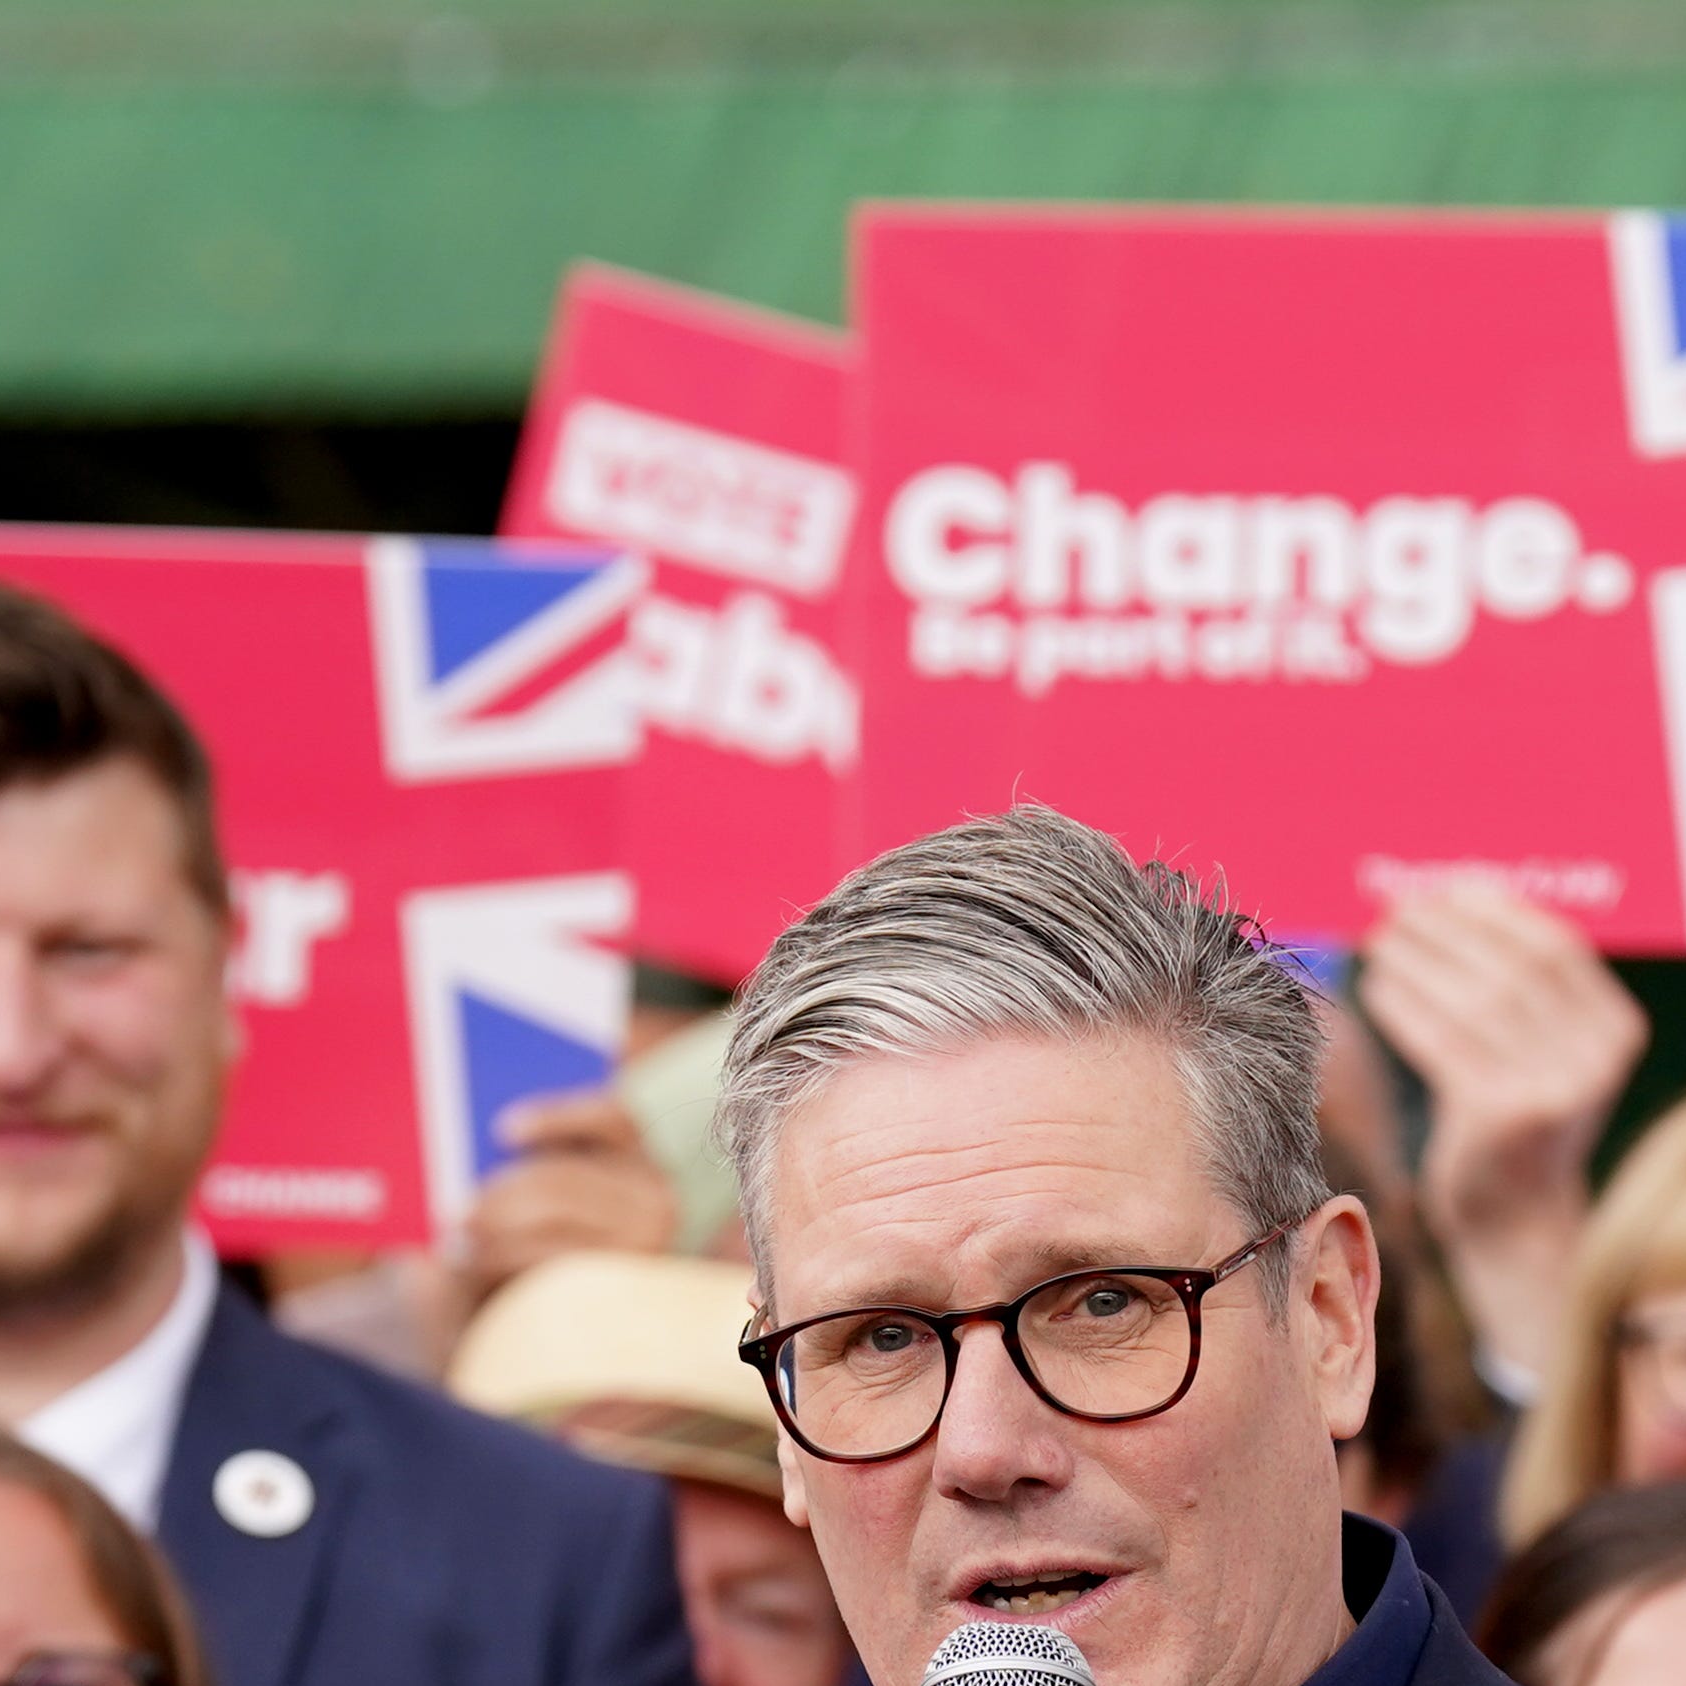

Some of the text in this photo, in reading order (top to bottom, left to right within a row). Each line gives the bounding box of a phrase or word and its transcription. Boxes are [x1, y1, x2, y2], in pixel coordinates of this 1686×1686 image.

[885, 463, 1632, 663] Change.
[913, 605, 1010, 680] Be
[1016, 605, 1194, 698] part
